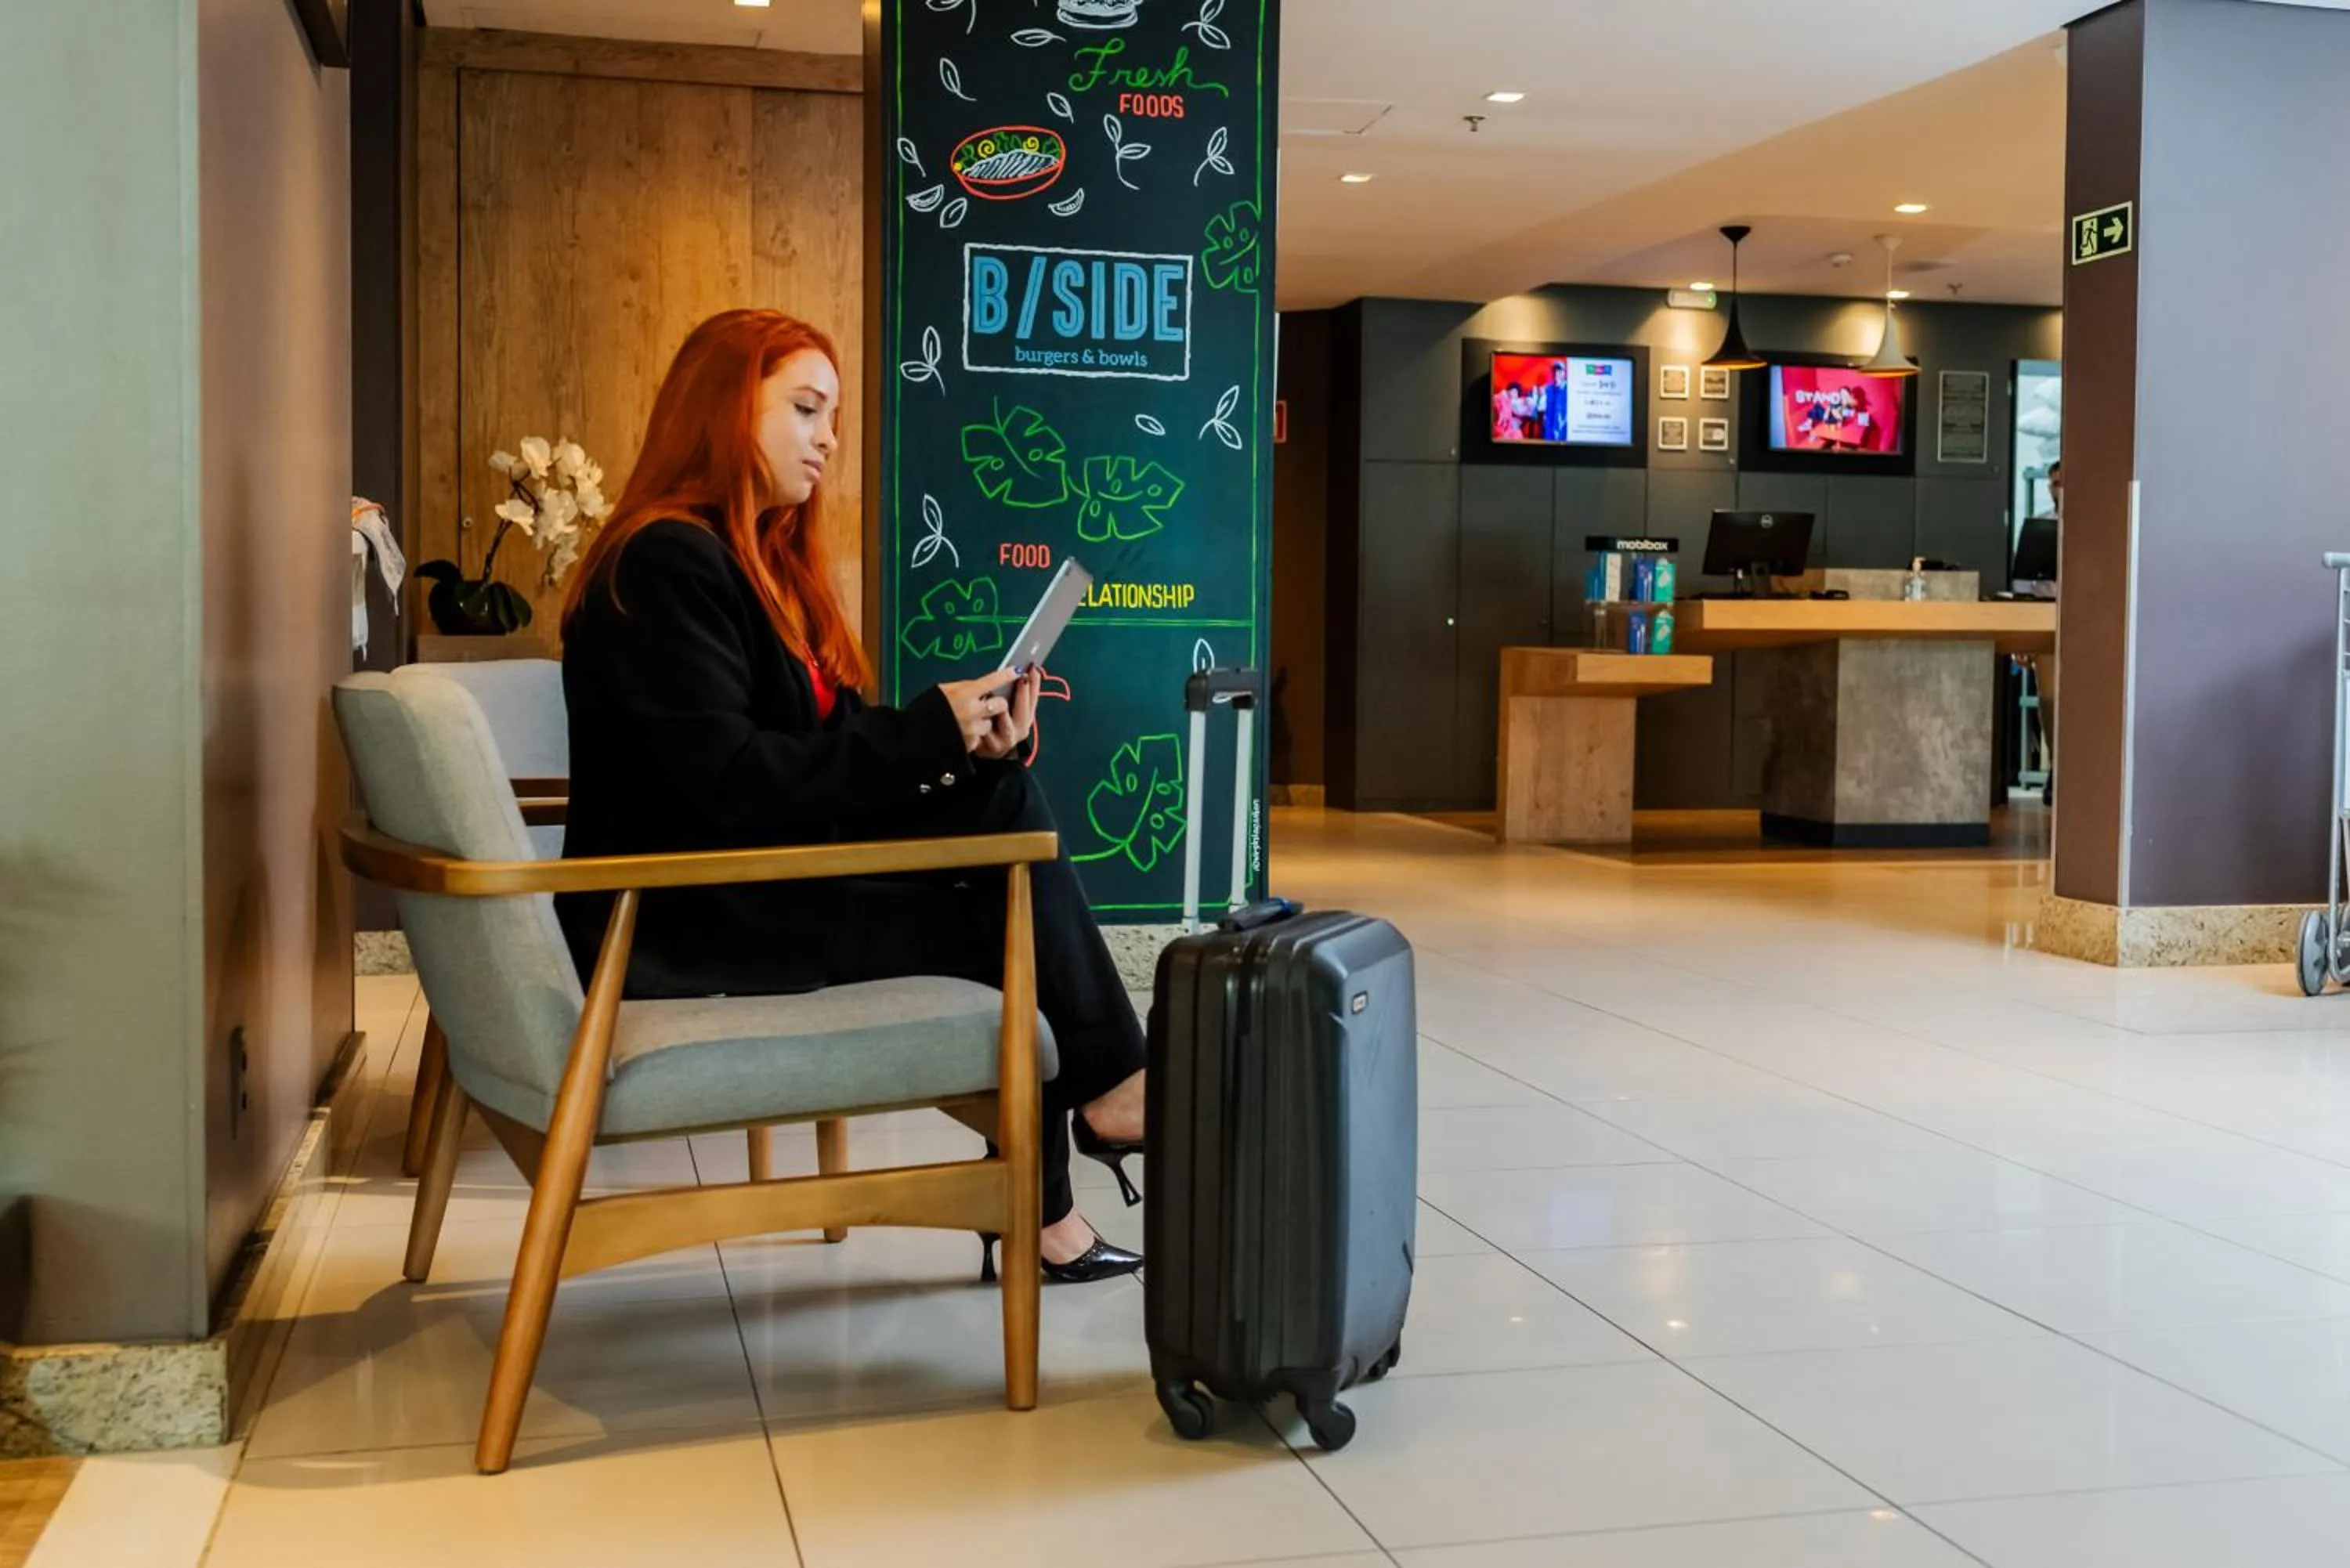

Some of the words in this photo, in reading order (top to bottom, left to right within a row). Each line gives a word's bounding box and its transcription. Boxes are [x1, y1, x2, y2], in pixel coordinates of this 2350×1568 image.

[1069, 38, 1228, 99] Fresh
[1119, 92, 1185, 119] FOODS
[972, 255, 1184, 342] B/SIDE
[1014, 345, 1079, 366] burgers
[1082, 349, 1095, 363] &
[1098, 349, 1148, 367] bowls
[1000, 543, 1051, 569] FOOD
